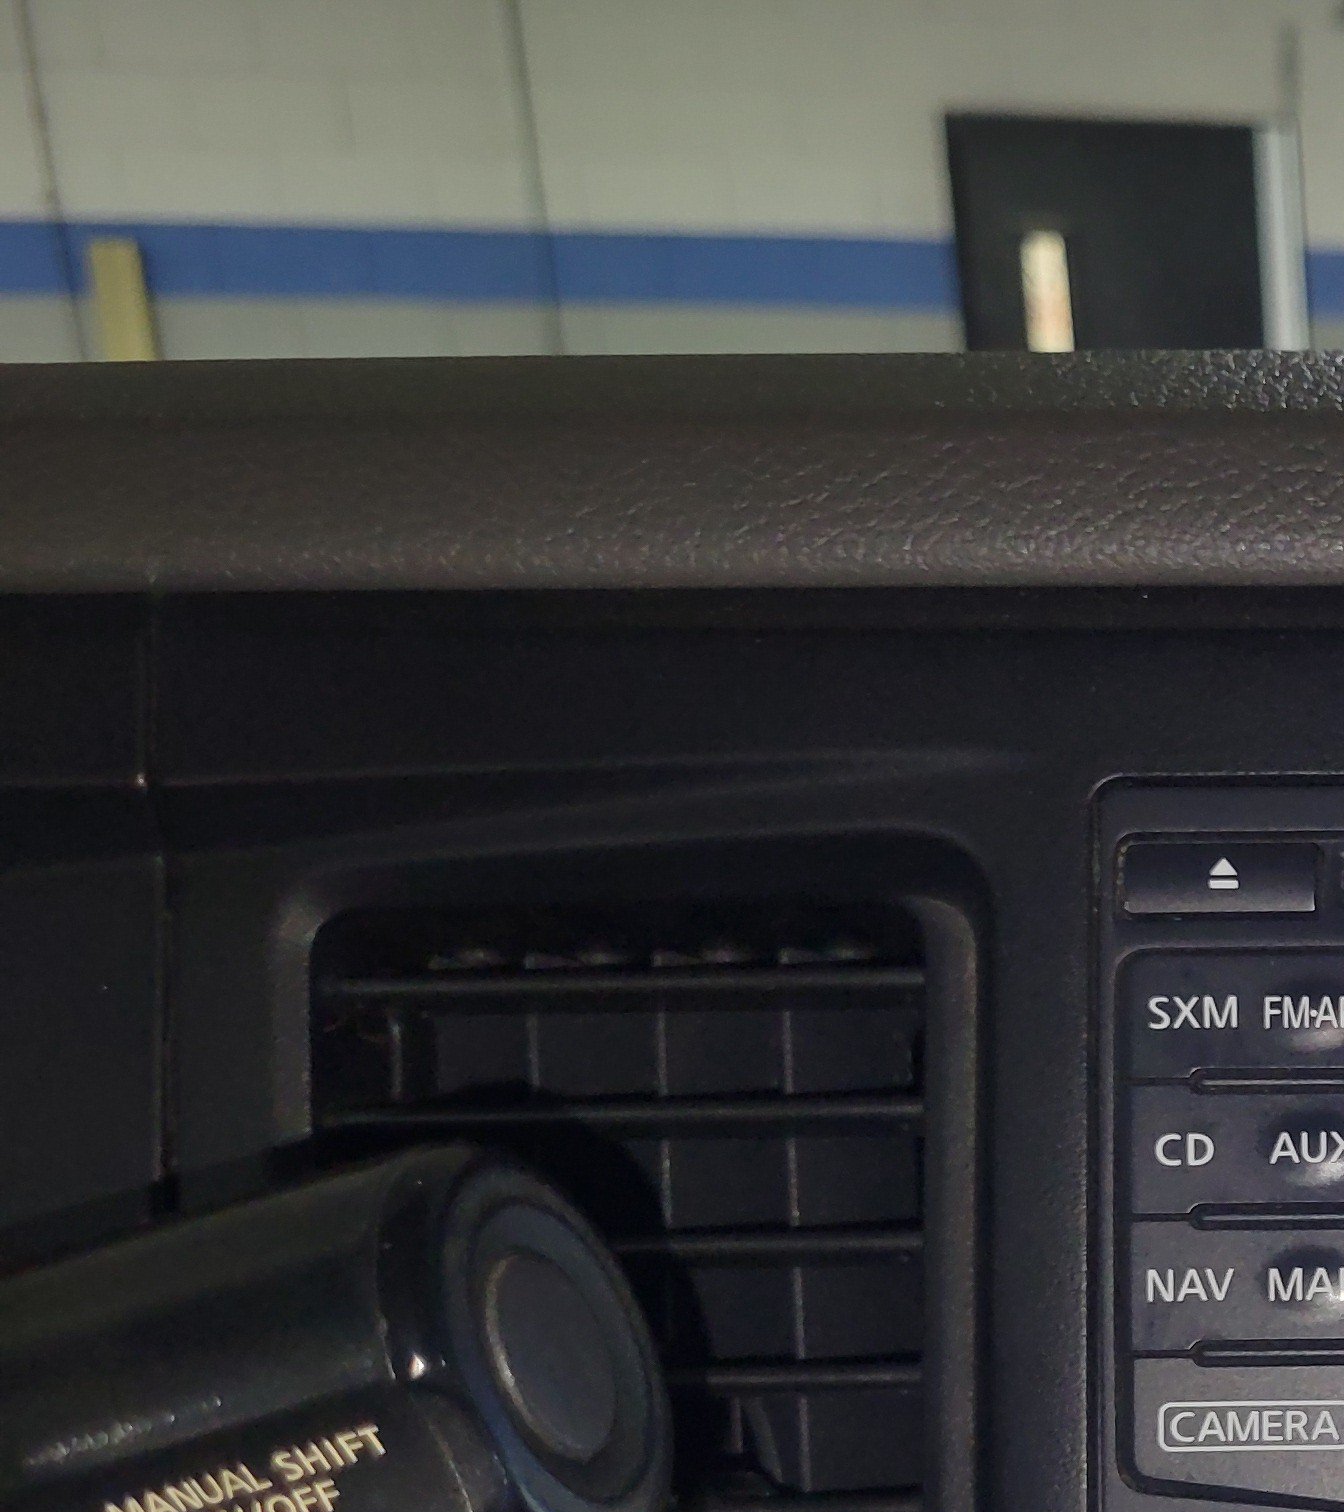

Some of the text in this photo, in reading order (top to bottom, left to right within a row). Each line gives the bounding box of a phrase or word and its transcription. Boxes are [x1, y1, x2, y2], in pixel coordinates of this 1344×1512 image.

[1147, 995, 1239, 1030] SXM
[1154, 1132, 1216, 1166] CD
[1146, 1267, 1236, 1303] NAV
[1169, 1410, 1340, 1443] CAMERA
[270, 1423, 388, 1482] SHIFT
